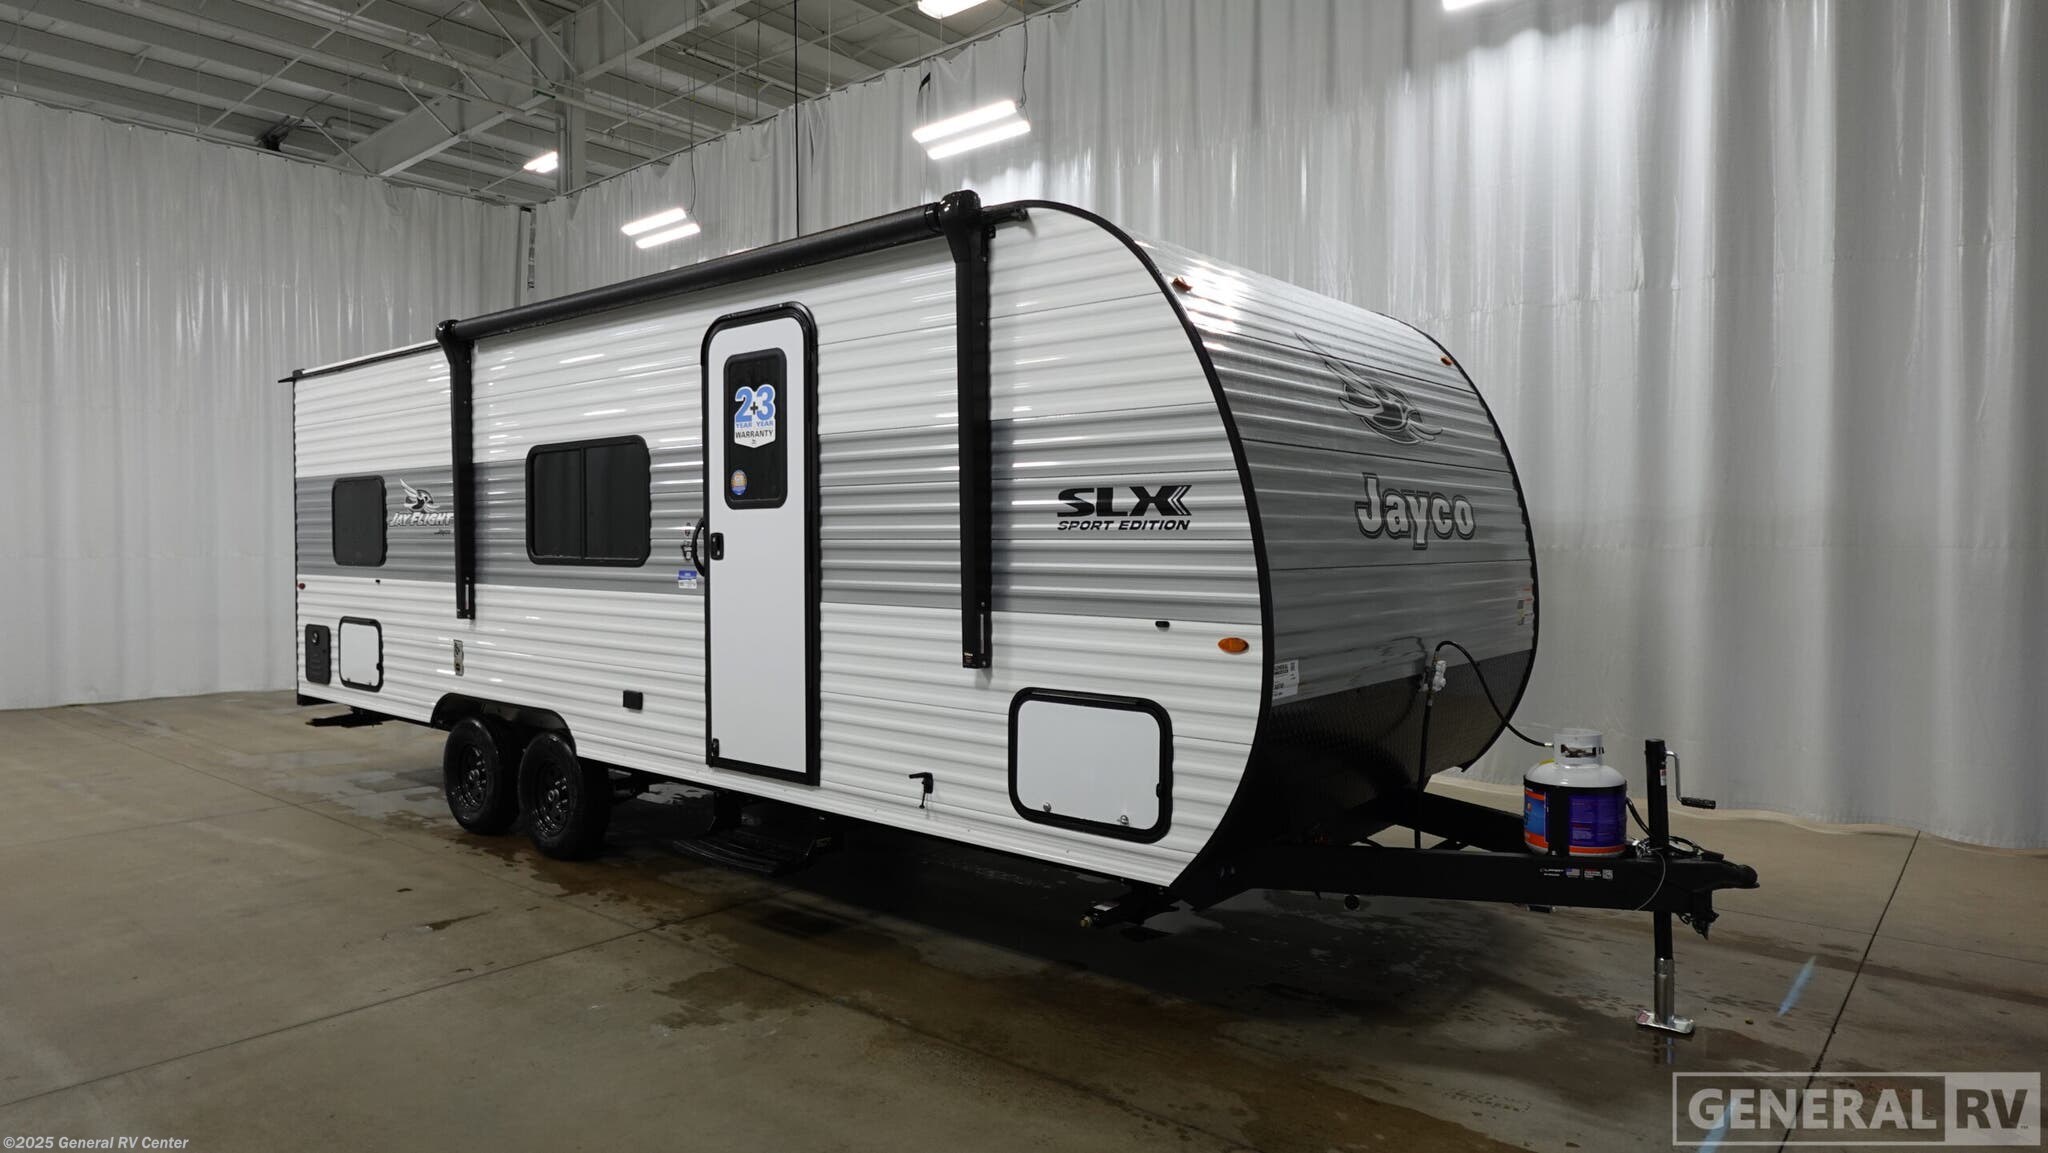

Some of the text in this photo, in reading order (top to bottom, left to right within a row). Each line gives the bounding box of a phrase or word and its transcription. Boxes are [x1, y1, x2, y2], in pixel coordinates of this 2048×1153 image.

[735, 430, 773, 438] WARRANTY
[1057, 485, 1192, 517] SLX
[1355, 472, 1476, 550] Jayco
[1057, 519, 1191, 531] SPORT EDITION
